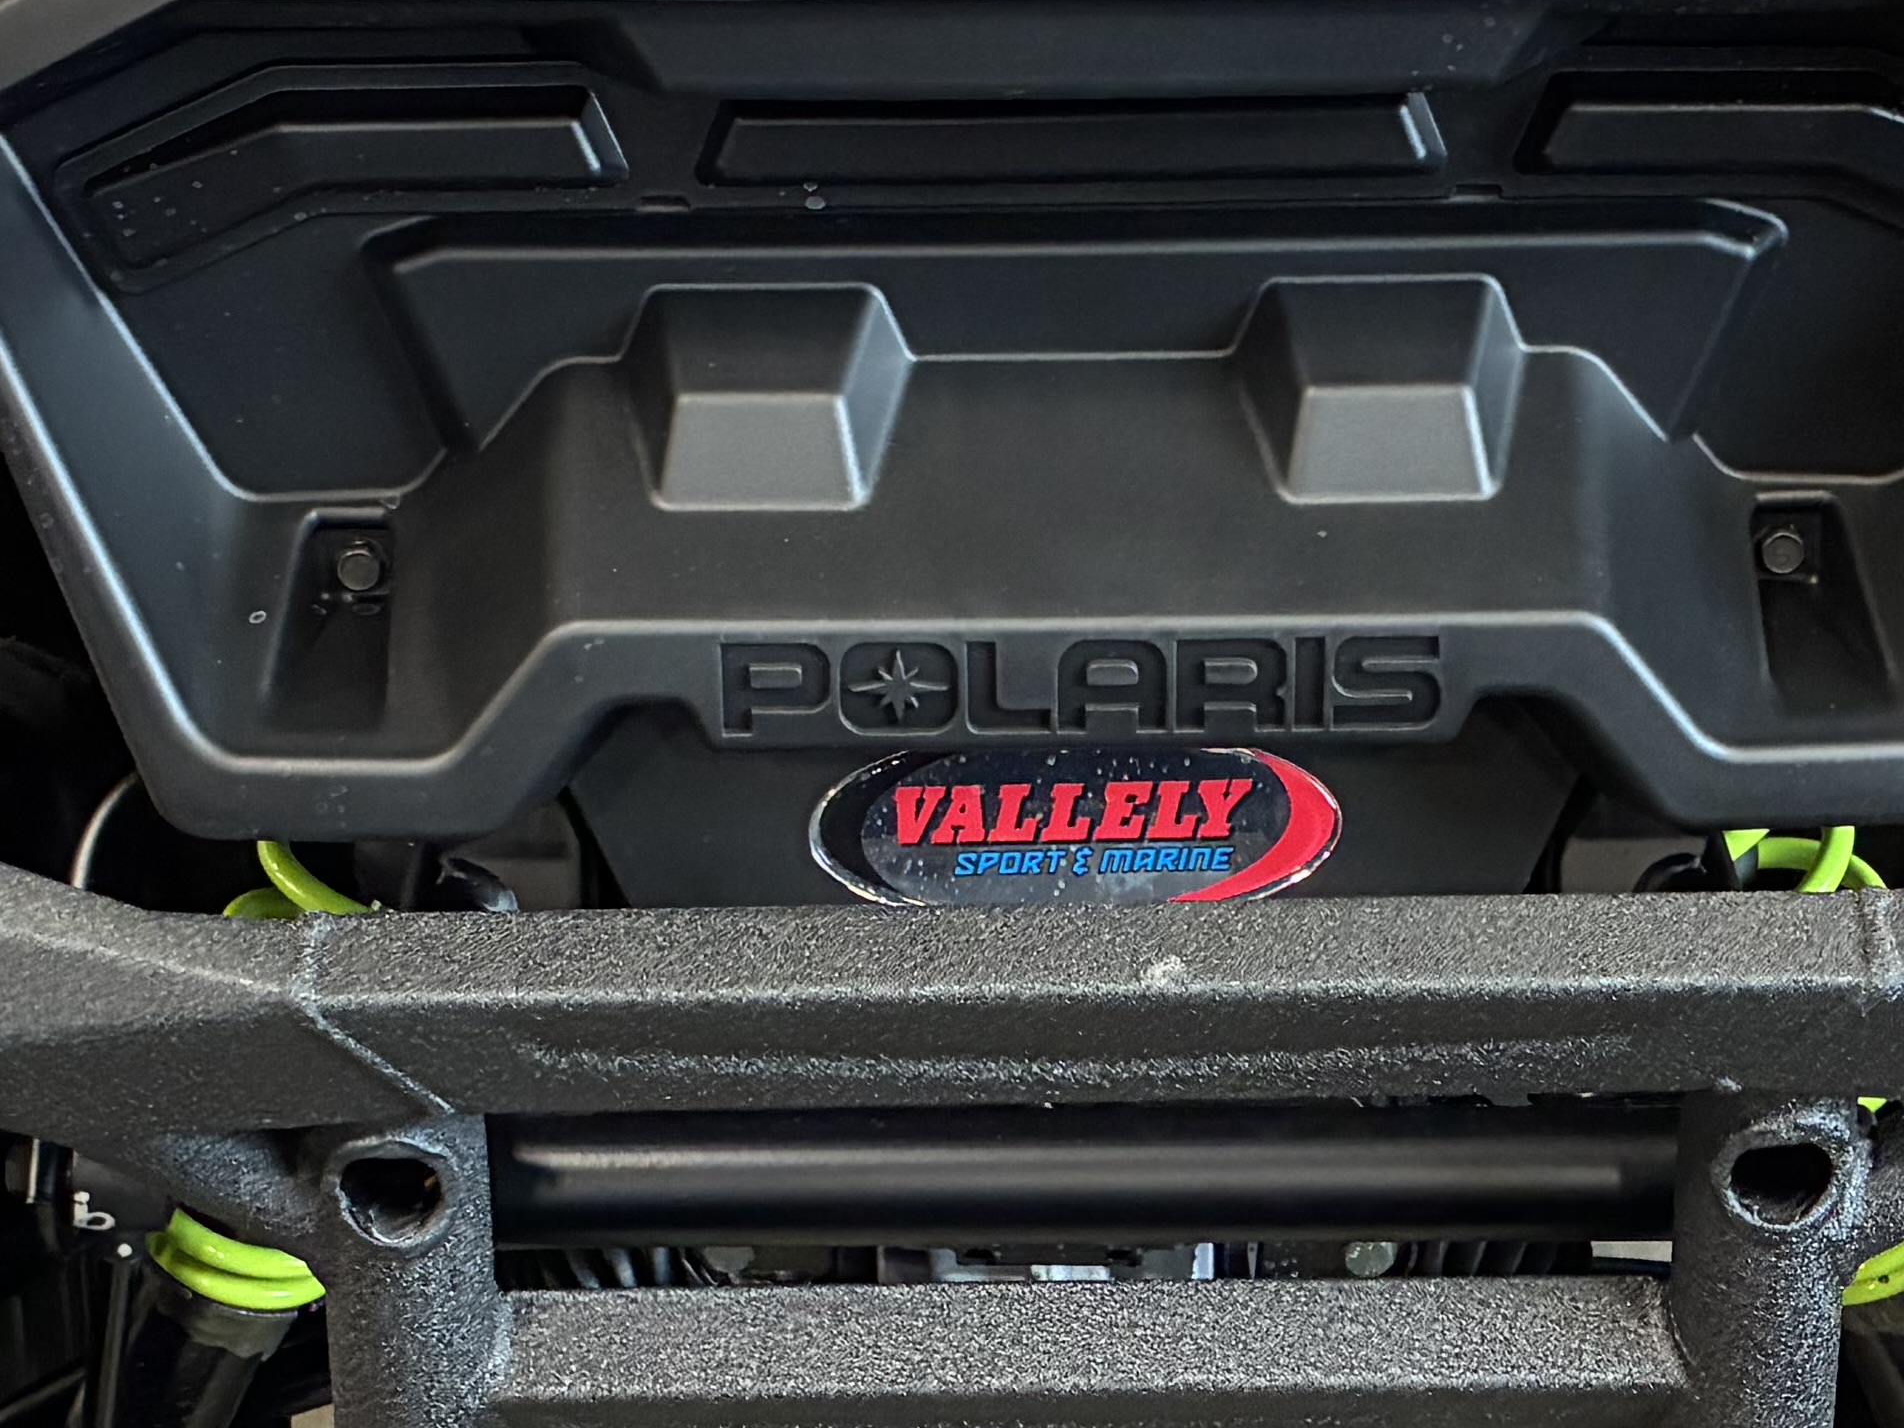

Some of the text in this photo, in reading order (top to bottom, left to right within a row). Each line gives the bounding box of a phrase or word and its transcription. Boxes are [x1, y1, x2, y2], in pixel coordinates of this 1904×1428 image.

[719, 635, 1444, 738] POLARIS
[892, 778, 1254, 846] VALLELY
[953, 846, 1235, 878] SPORT & MARINE
